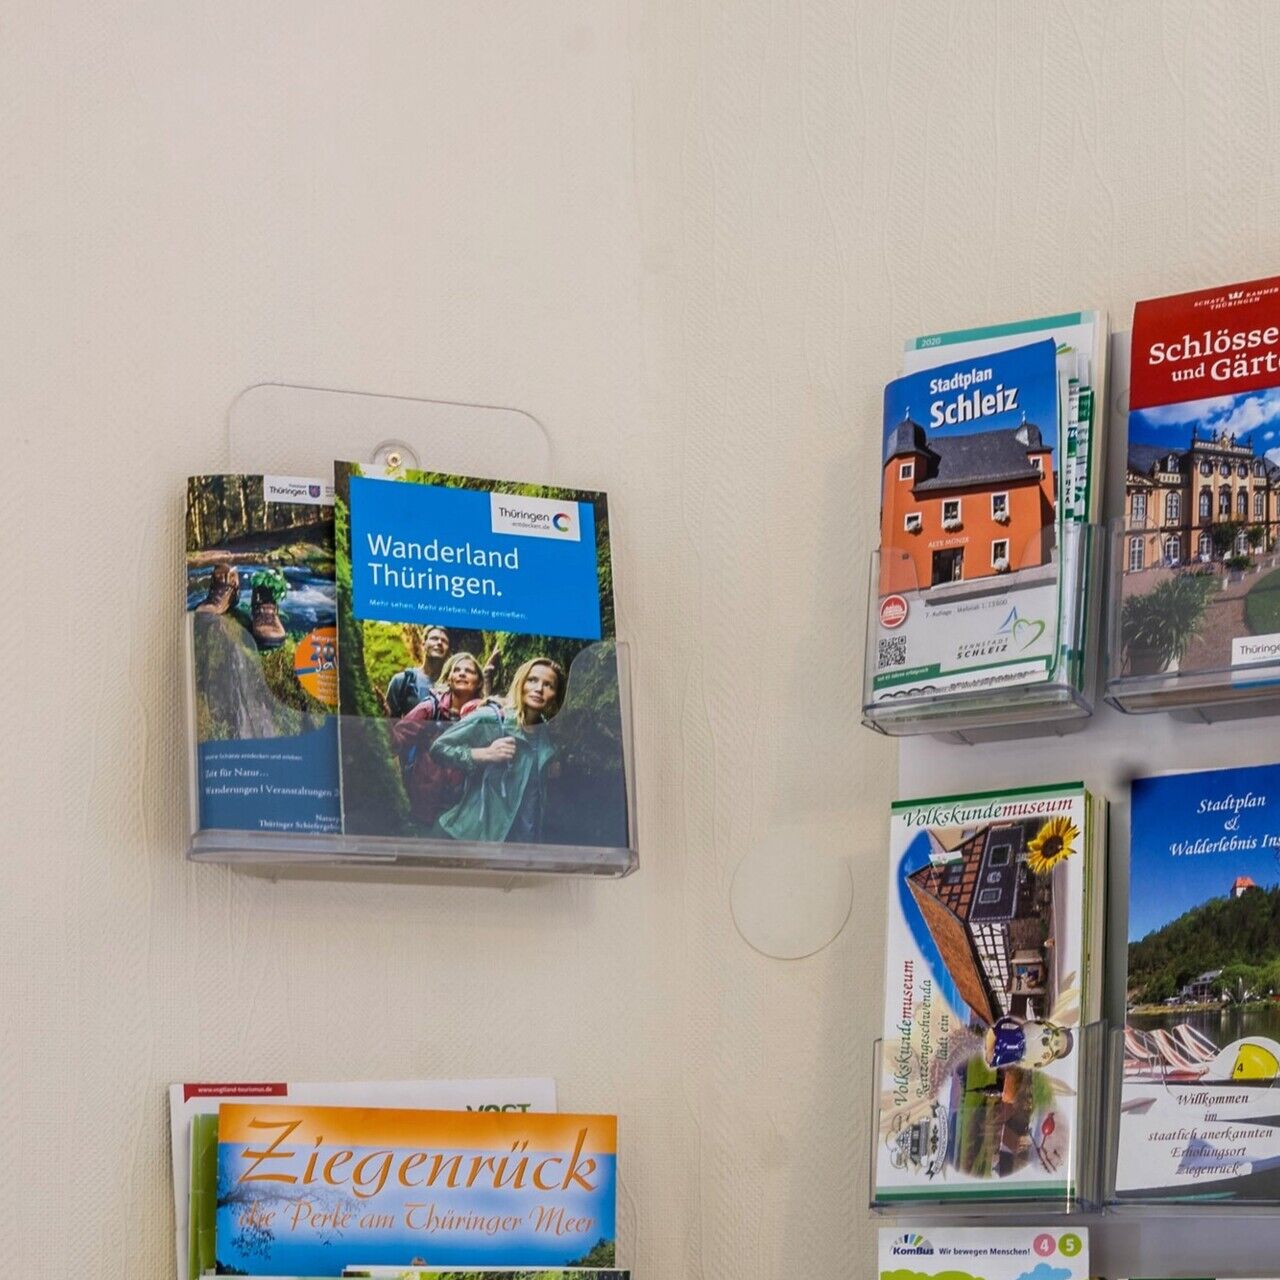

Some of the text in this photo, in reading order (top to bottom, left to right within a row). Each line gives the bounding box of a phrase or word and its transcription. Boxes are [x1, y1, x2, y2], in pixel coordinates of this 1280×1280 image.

[922, 338, 941, 347] 2020
[929, 368, 993, 394] Stadtplan
[1172, 363, 1205, 382] und
[929, 384, 1019, 429] Schleiz
[270, 486, 307, 497] Thüringen
[499, 507, 549, 522] Thüringen
[367, 533, 519, 570] Wanderland
[368, 562, 503, 598] Thüringen.
[957, 645, 1008, 659] SCHLEIZ
[1197, 792, 1266, 814] Stadtplan
[903, 799, 1073, 828] Volkskundemuseum
[1170, 835, 1257, 857] Walderlebnis
[894, 962, 914, 1107] Volkskundemuseum
[1176, 1092, 1249, 1105] Willkommen
[1204, 1112, 1218, 1122] im
[237, 1116, 600, 1199] Ziegenrück
[893, 1247, 934, 1256] KomBus
[954, 1248, 988, 1257] bewegen
[990, 1248, 1030, 1256] Menschen!
[1040, 1239, 1074, 1251] 4 5
